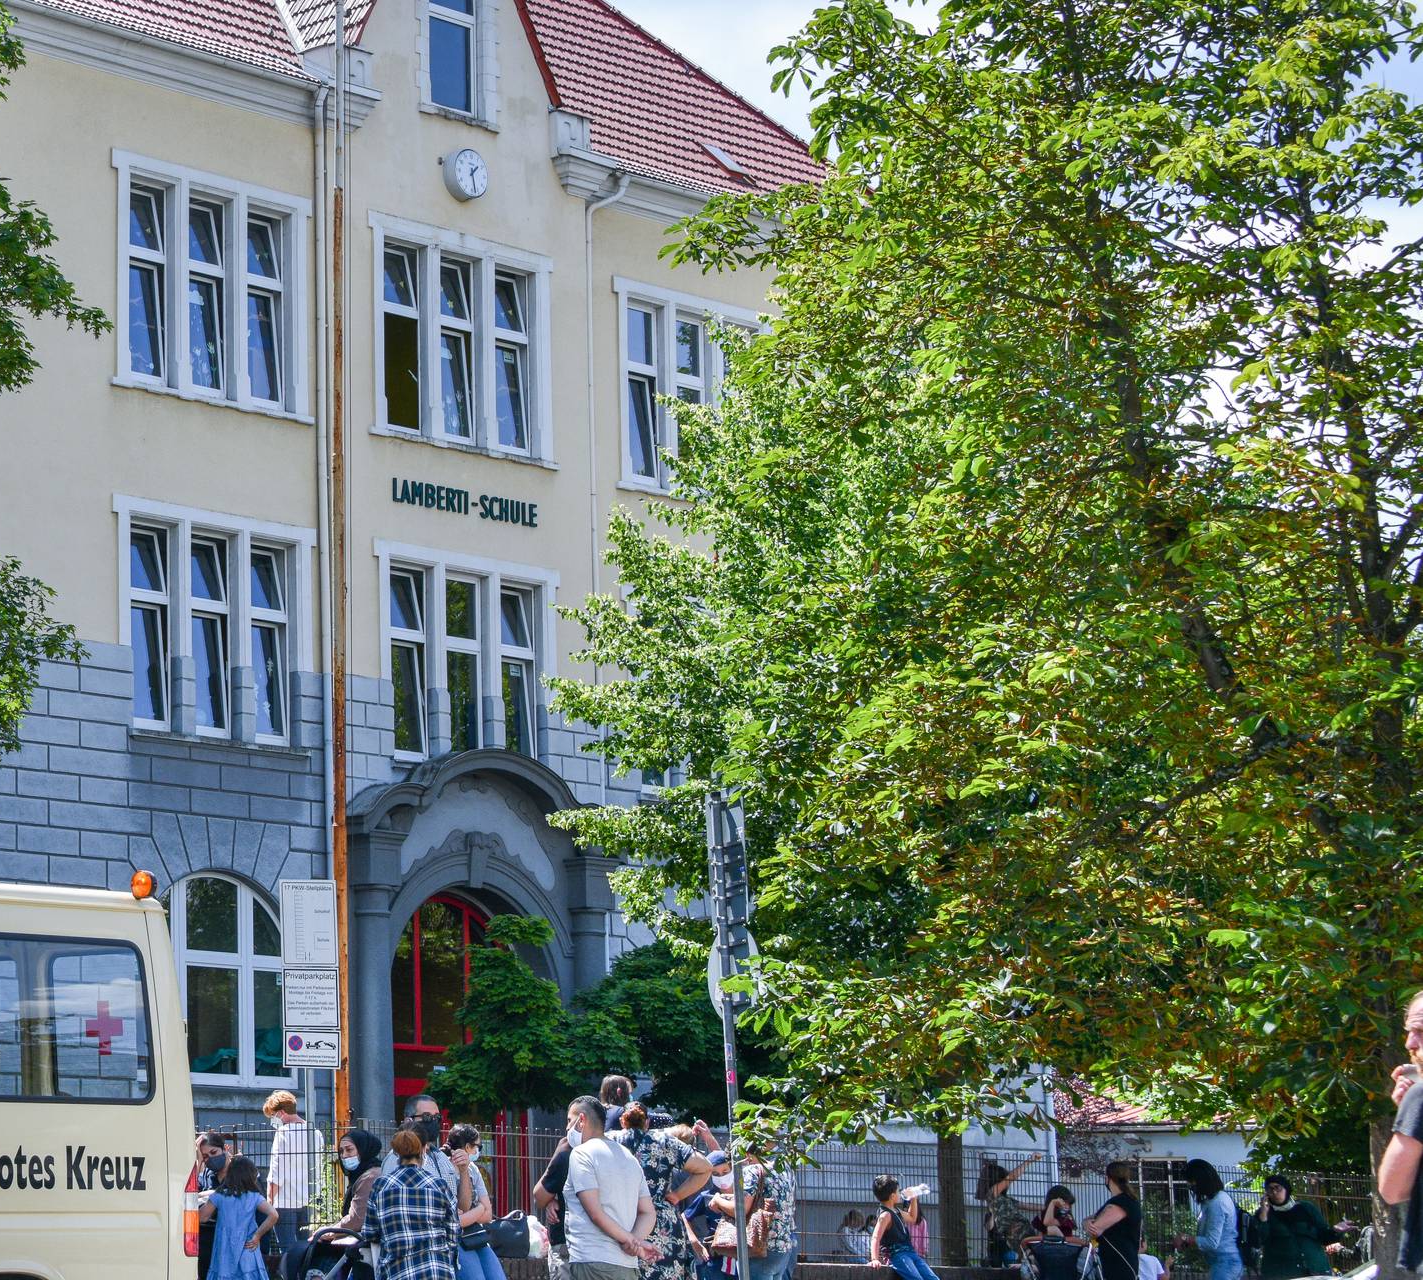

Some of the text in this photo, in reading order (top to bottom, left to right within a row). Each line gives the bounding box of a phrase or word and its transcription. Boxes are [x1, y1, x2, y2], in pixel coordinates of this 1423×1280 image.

[392, 478, 538, 528] LAMBERTI-SCHULE
[285, 971, 336, 981] Privatparkplatz
[65, 1145, 147, 1191] Kreuz
